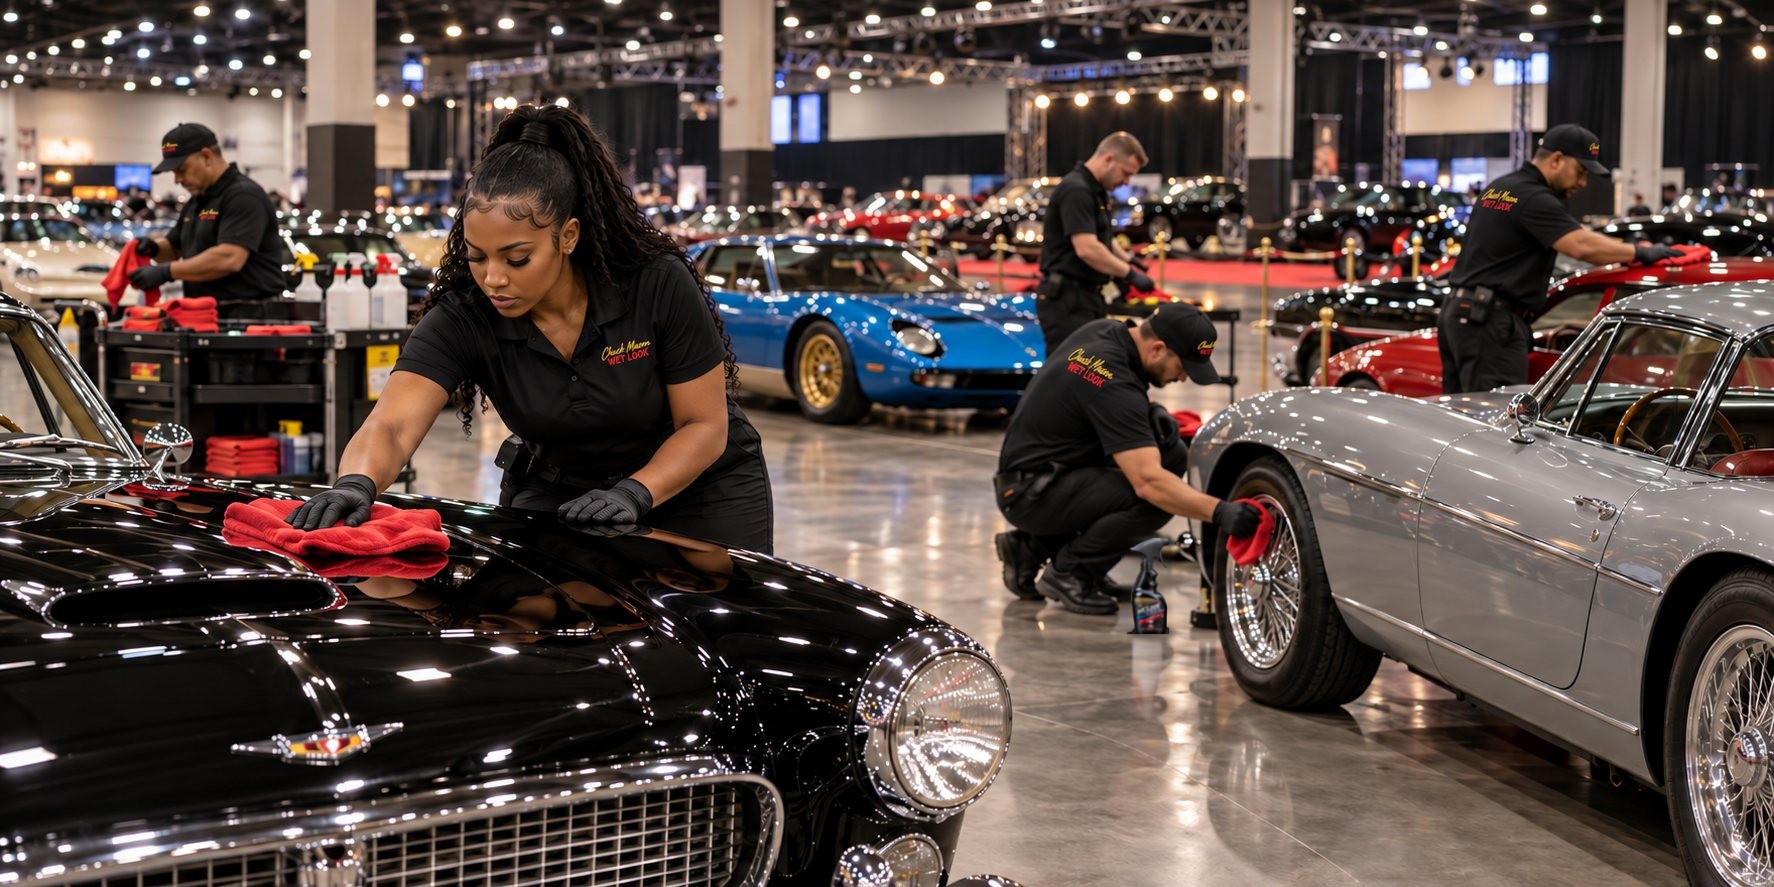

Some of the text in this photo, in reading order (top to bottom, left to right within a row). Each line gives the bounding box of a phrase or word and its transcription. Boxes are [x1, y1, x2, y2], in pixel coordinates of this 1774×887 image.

[601, 342, 626, 361] Chuck
[607, 347, 650, 366] WET LOOK
[1067, 361, 1105, 388] WET LOOK
